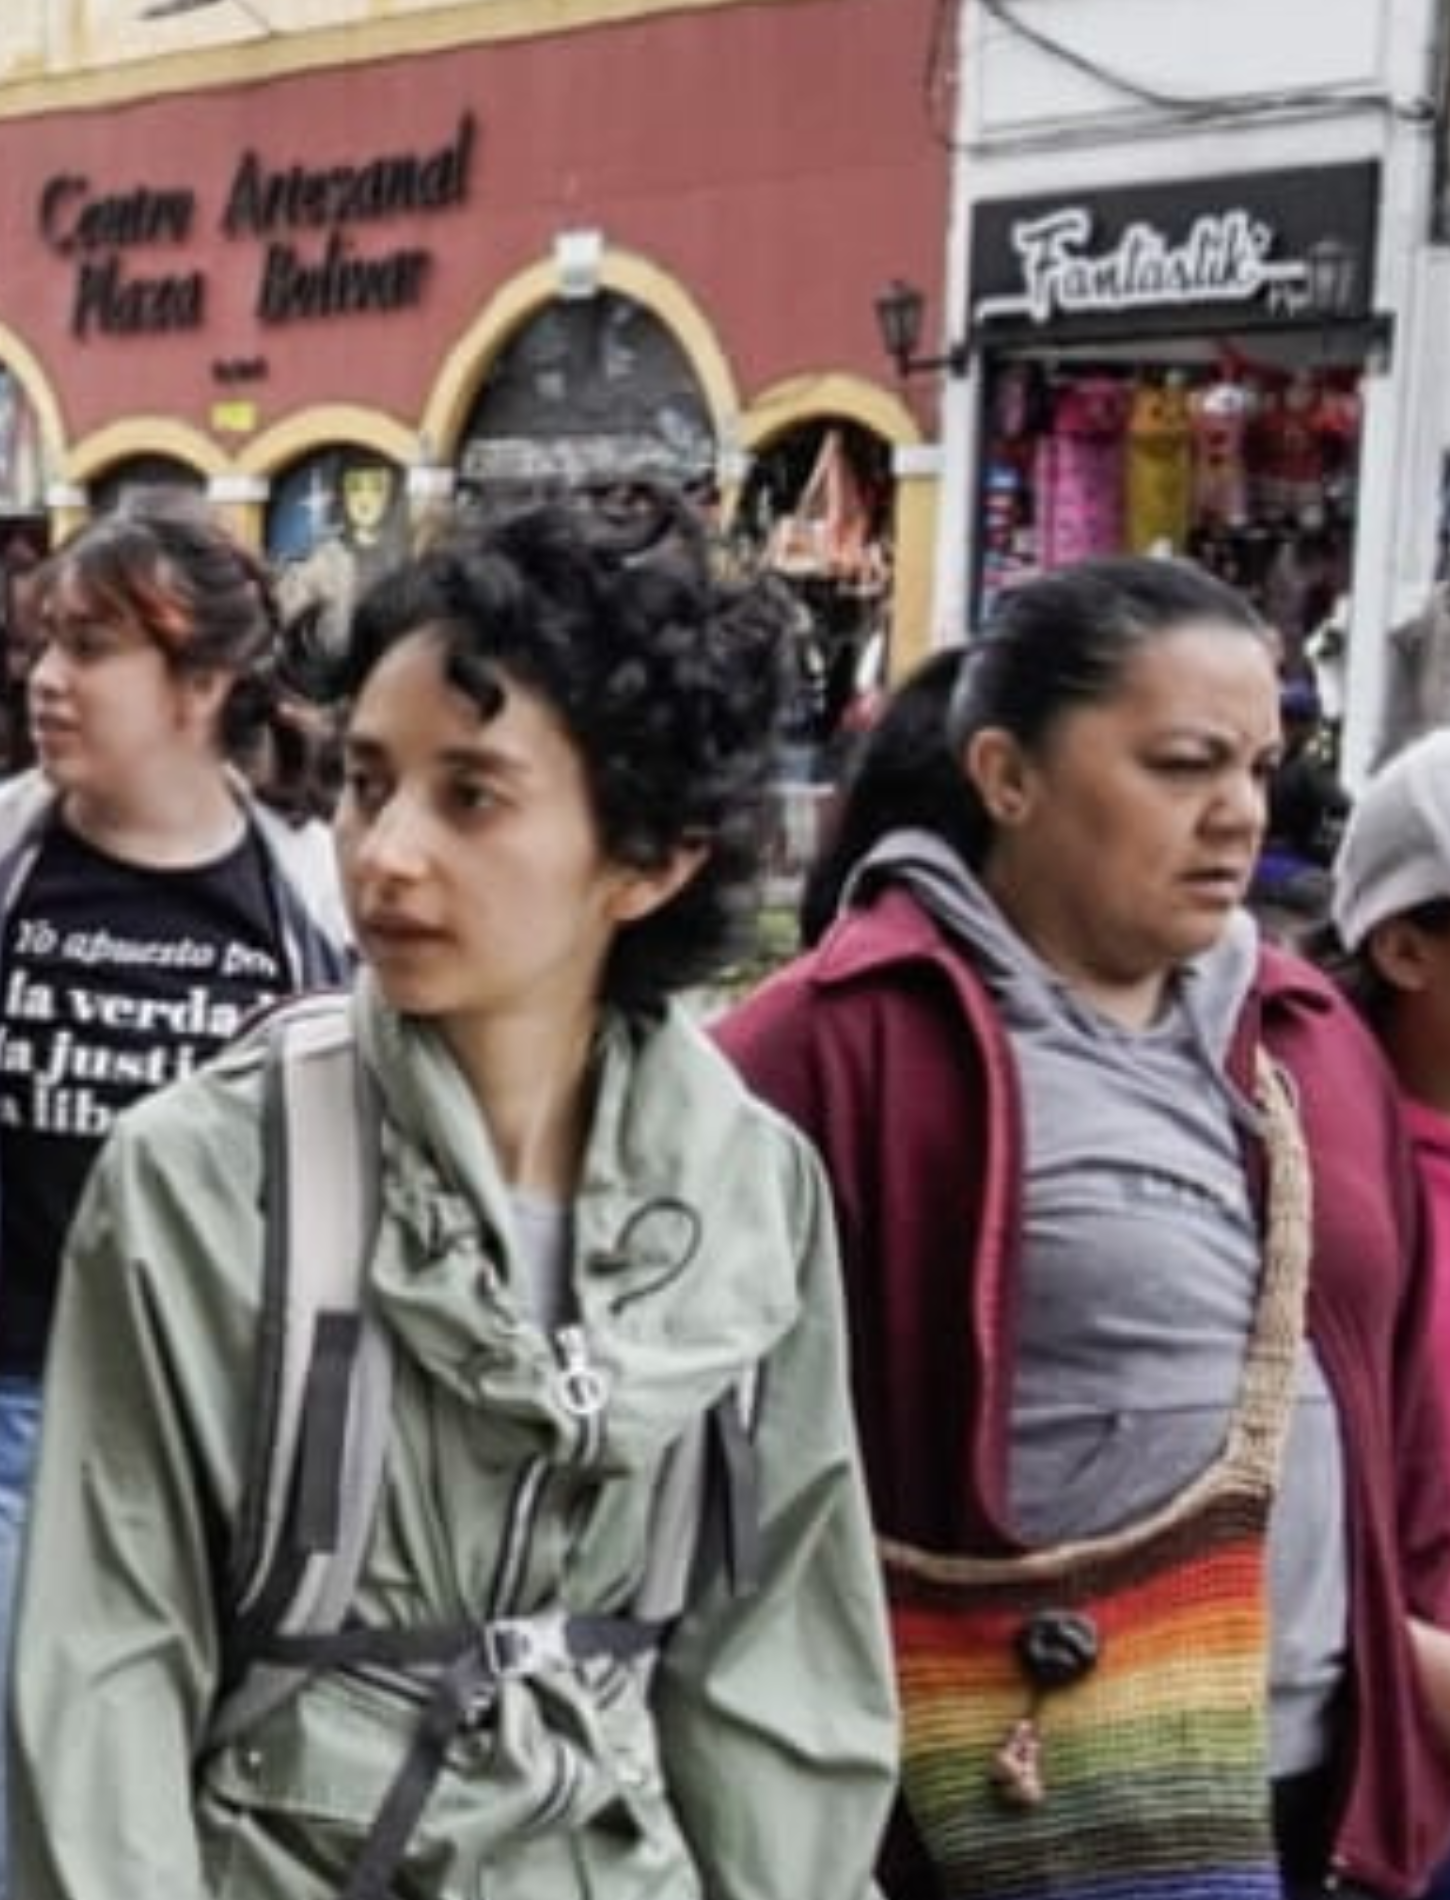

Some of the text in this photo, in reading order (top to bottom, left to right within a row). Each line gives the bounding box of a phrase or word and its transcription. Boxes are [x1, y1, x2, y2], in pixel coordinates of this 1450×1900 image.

[40, 110, 477, 256] Centro Artesanal
[70, 244, 206, 344] Plaza
[14, 917, 58, 954] Yo
[61, 928, 216, 968] apuesto
[4, 969, 272, 1040] la verda
